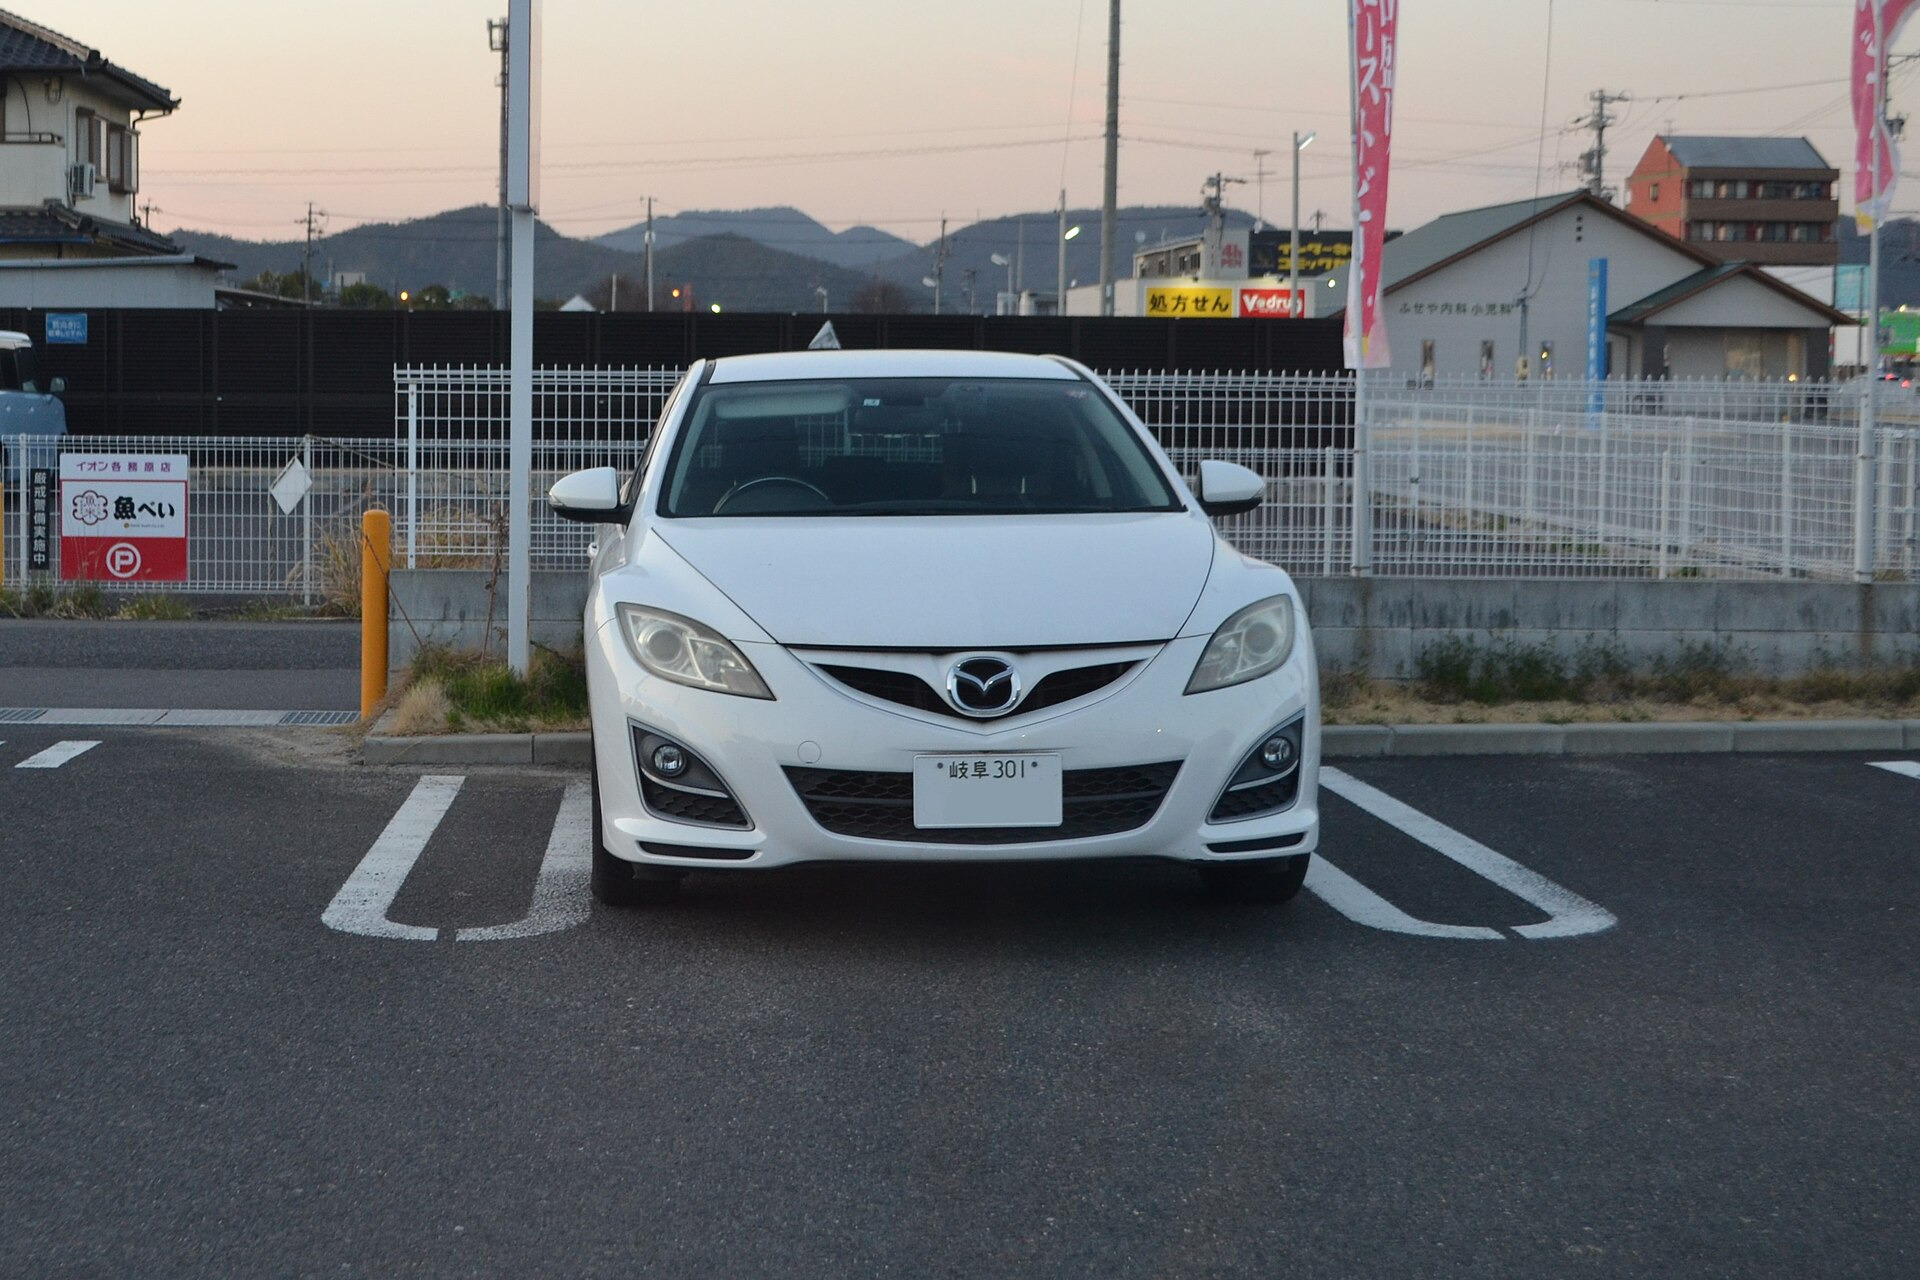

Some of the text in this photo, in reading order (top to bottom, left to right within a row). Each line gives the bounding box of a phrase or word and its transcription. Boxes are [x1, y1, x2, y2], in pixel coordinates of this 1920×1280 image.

[1149, 293, 1230, 313] 処方せん
[76, 461, 171, 473] イオン各務原店
[113, 496, 176, 520] 魚べい
[115, 550, 135, 571] P
